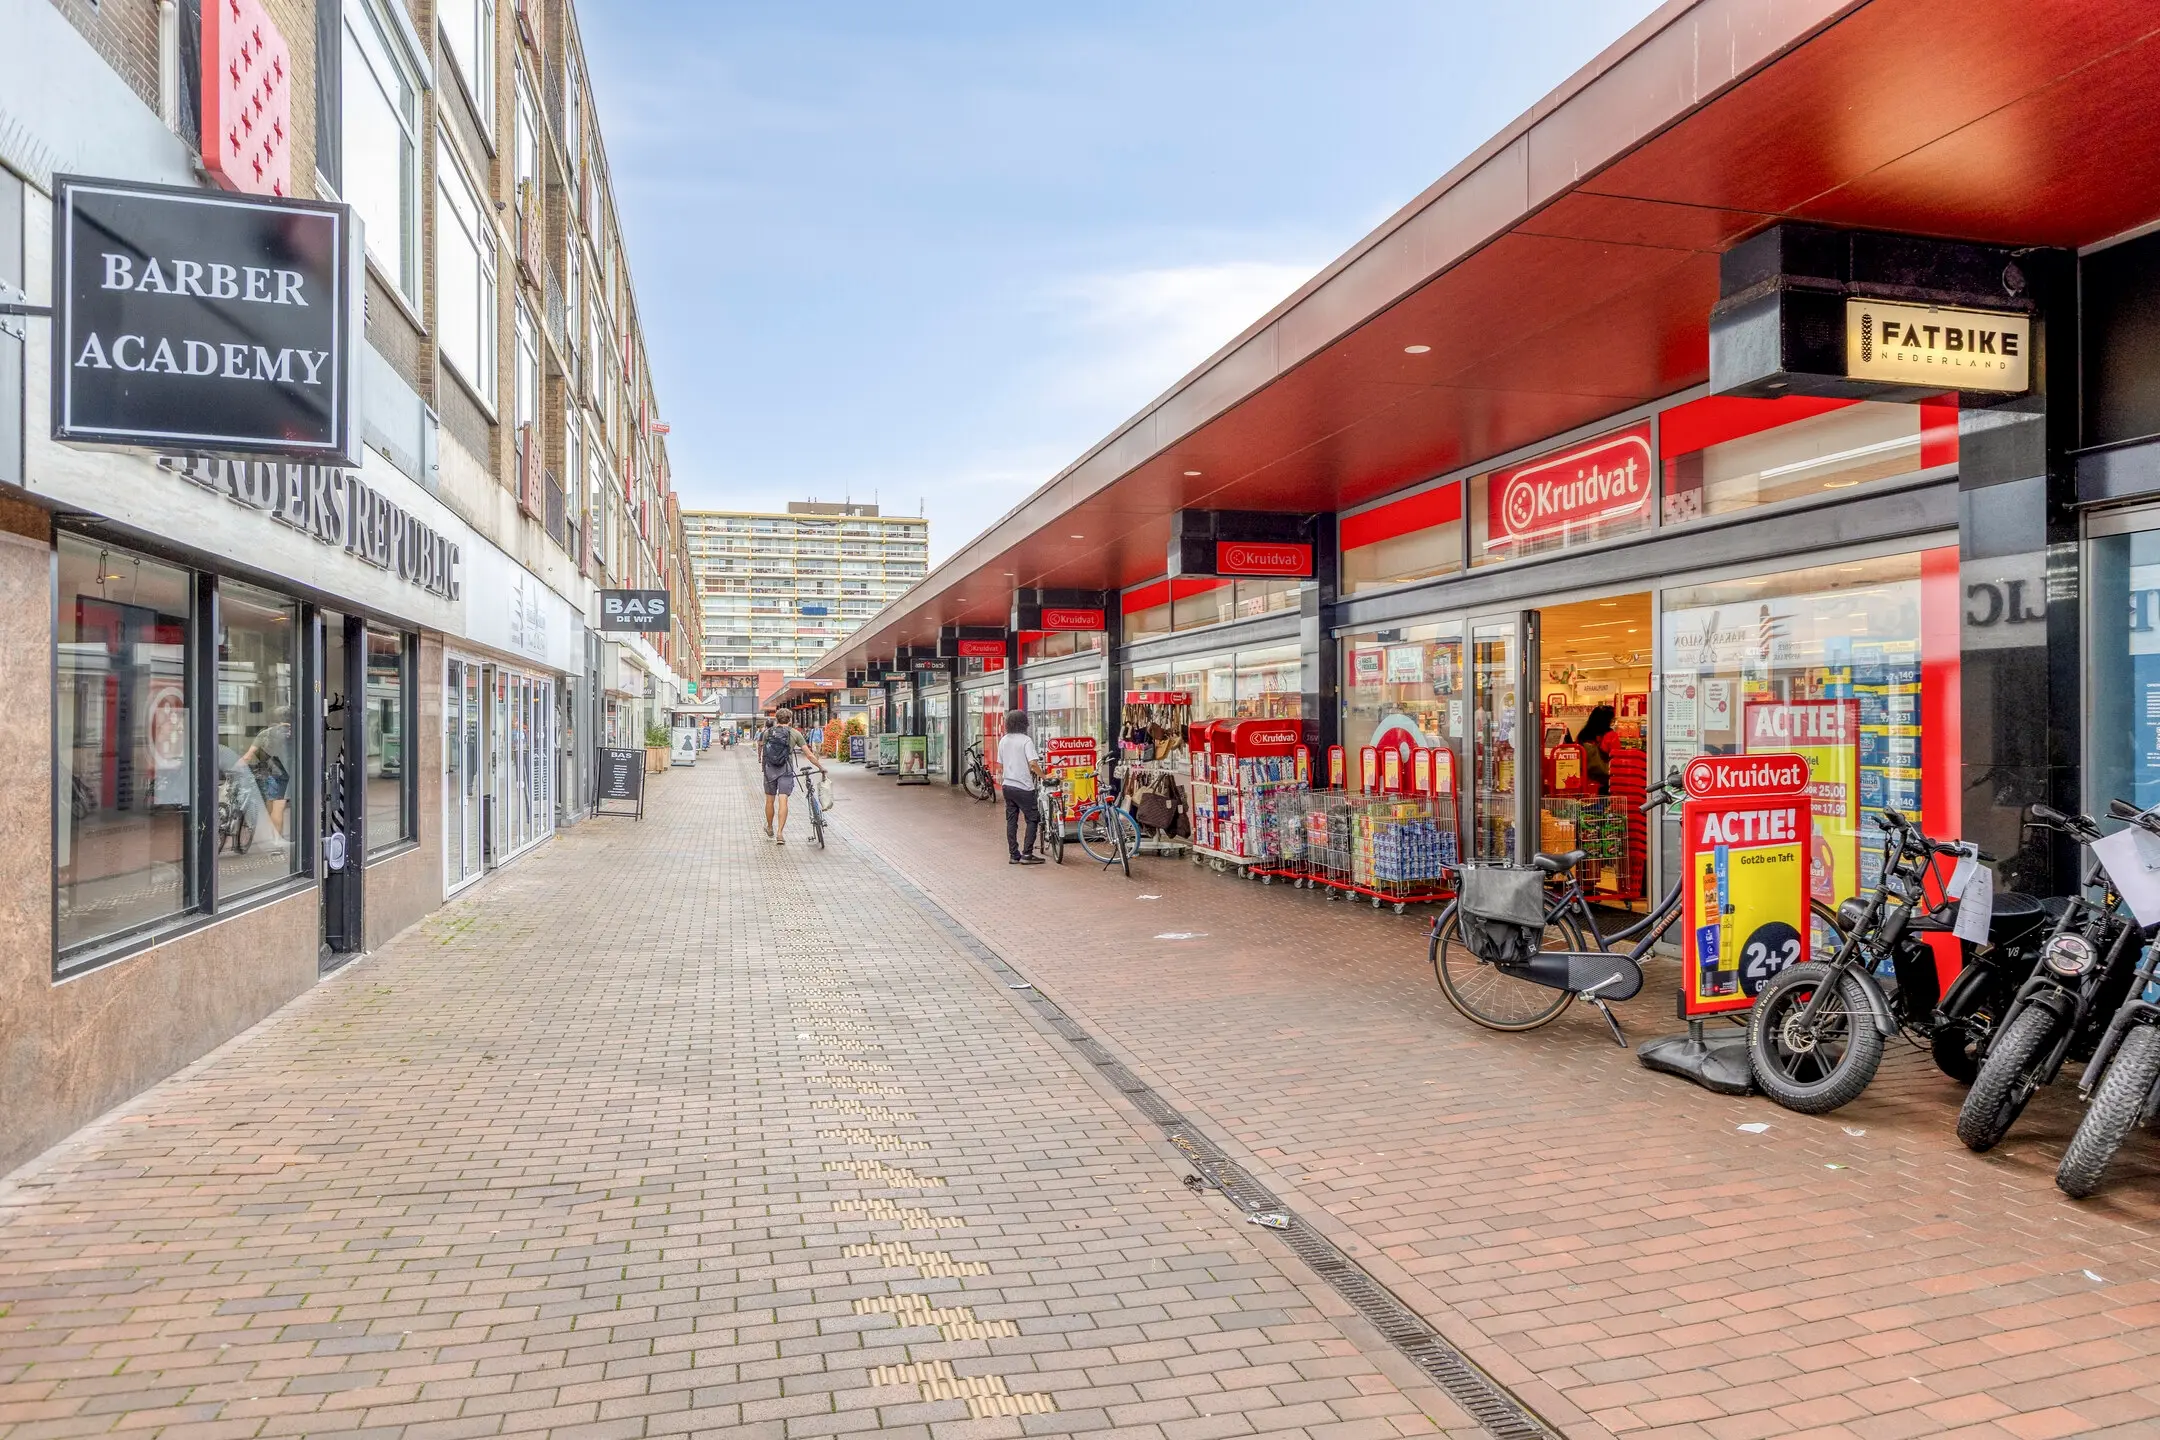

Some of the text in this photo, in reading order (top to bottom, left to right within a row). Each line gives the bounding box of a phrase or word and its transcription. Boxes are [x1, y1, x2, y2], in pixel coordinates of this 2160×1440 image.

[101, 252, 309, 306] BARBER
[1882, 320, 2019, 357] FATBIKE
[74, 331, 330, 385] ACADEMY
[1881, 350, 2006, 370] NEDERLAND
[1537, 457, 1639, 518] Kruidvat
[345, 474, 460, 601] REPUBLIC
[1246, 551, 1298, 566] Kruidvat
[605, 598, 666, 614] BAS
[616, 615, 631, 623] DE
[1061, 613, 1095, 625] Kruidvat
[972, 644, 999, 653] Kruidvat
[1899, 670, 1914, 679] 140
[1754, 703, 1847, 740] ACTIE!
[1896, 712, 1911, 722] 231
[1059, 739, 1093, 749] Kruidvat
[1262, 733, 1294, 743] Kruidvat
[1896, 755, 1911, 764] 231
[1716, 763, 1802, 789] Kruidvat
[1818, 783, 1846, 798] 25.00
[1823, 803, 1846, 815] 17.99
[1900, 798, 1914, 807] 140
[1701, 807, 1797, 844] ACTIE!
[1740, 852, 1795, 866] Got2b en Taft
[1745, 938, 1801, 978] 2+2
[1759, 985, 1779, 1007] Terrain
